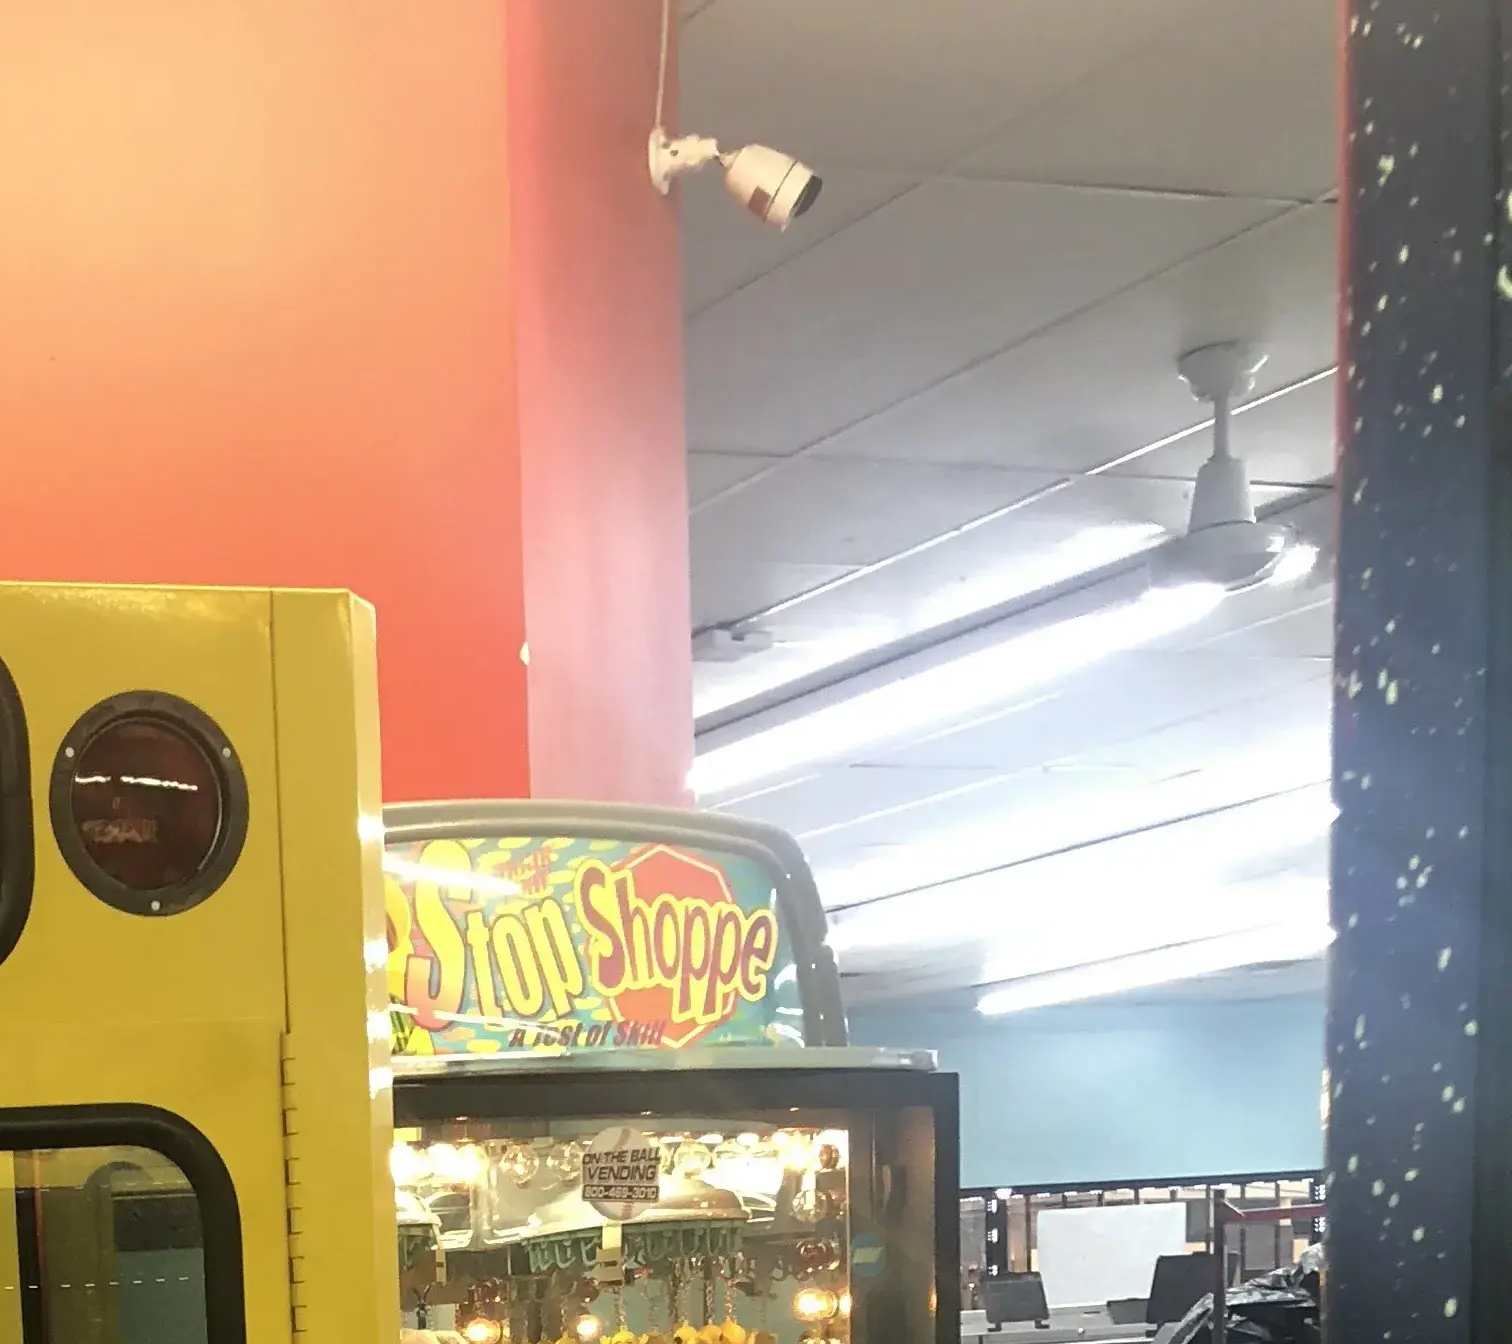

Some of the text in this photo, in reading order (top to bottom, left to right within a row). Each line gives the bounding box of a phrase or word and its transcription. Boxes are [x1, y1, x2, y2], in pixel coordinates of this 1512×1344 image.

[574, 858, 778, 1024] Shoppe
[582, 1146, 661, 1165] ON THE BALL
[588, 1164, 657, 1181] VENDING
[585, 1186, 657, 1199] 800-469-3010
